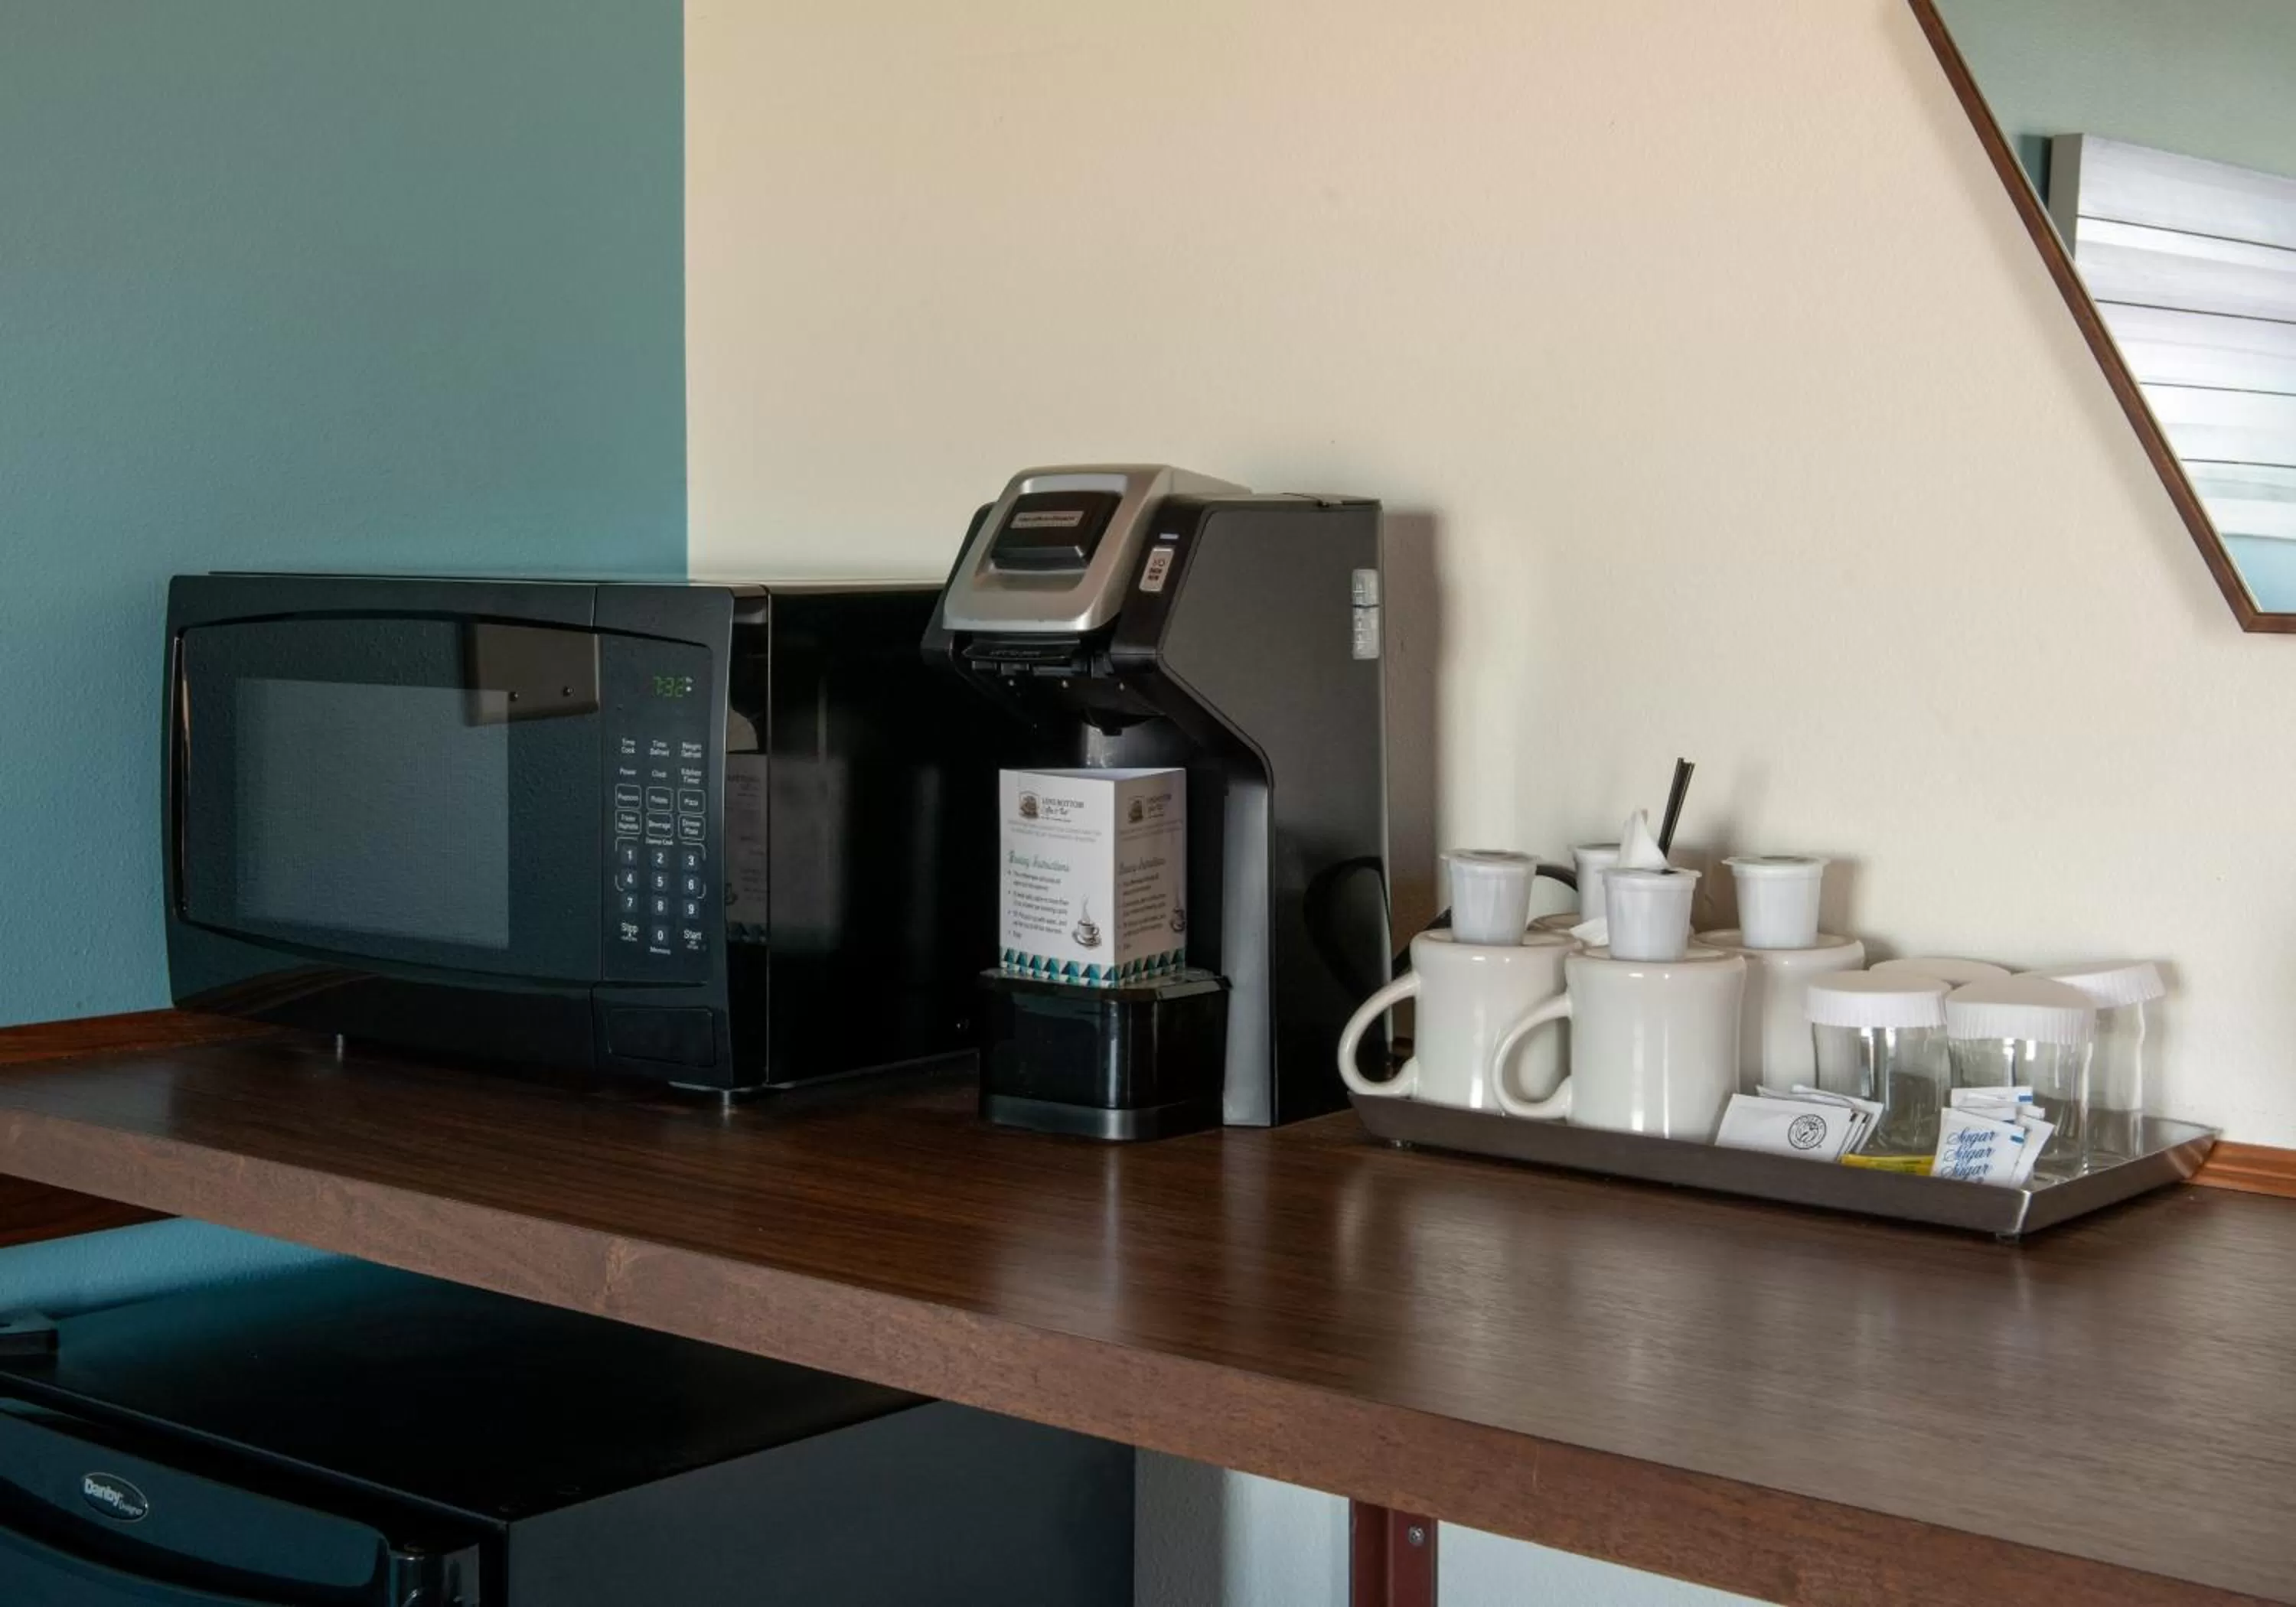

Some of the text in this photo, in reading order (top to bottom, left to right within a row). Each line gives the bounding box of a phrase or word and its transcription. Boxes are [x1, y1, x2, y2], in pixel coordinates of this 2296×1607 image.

[627, 850, 633, 860] 1
[657, 852, 664, 863] 2
[688, 856, 695, 865] 3
[627, 873, 633, 884] 4
[657, 876, 664, 887] 5
[688, 879, 694, 890] 6
[627, 897, 633, 907] 7
[657, 901, 664, 911] 8
[688, 904, 694, 914] 9
[657, 930, 664, 941] 0
[683, 929, 702, 940] Start
[1946, 1126, 1996, 1146] Sugar
[1942, 1145, 1994, 1164] Sugar
[1940, 1162, 1990, 1181] Sugar
[84, 1478, 120, 1507] Danby
